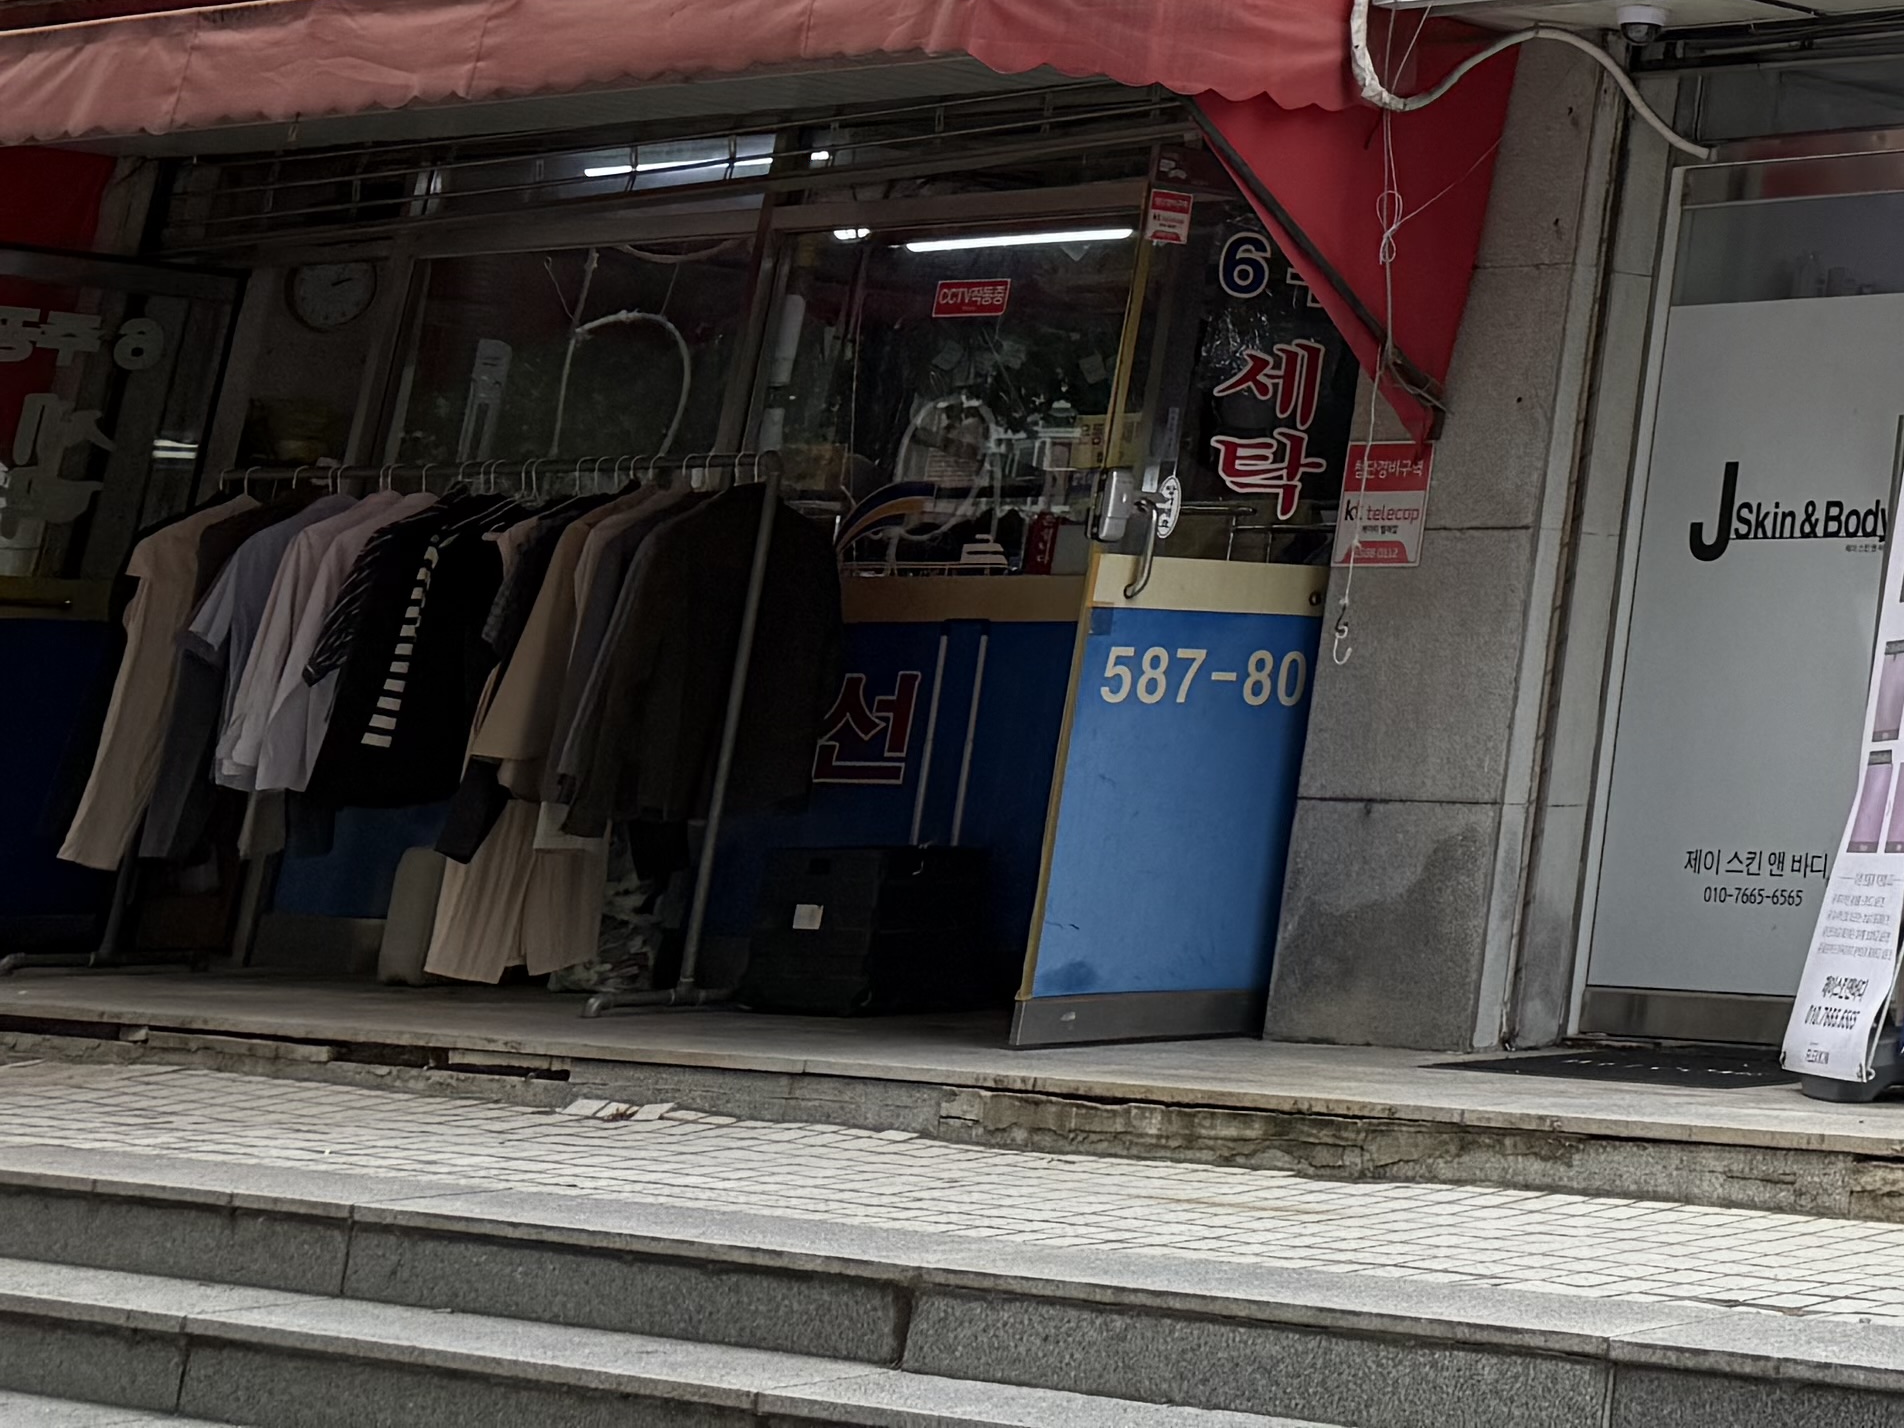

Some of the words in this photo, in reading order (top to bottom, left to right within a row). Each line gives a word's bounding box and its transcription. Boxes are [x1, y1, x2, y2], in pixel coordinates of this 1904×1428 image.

[1367, 505, 1420, 524] telecop
[1683, 848, 1721, 876] 제이
[1725, 849, 1763, 876] 스킨
[1790, 851, 1828, 879] 바디
[1703, 885, 1803, 908] 010-7665-6565
